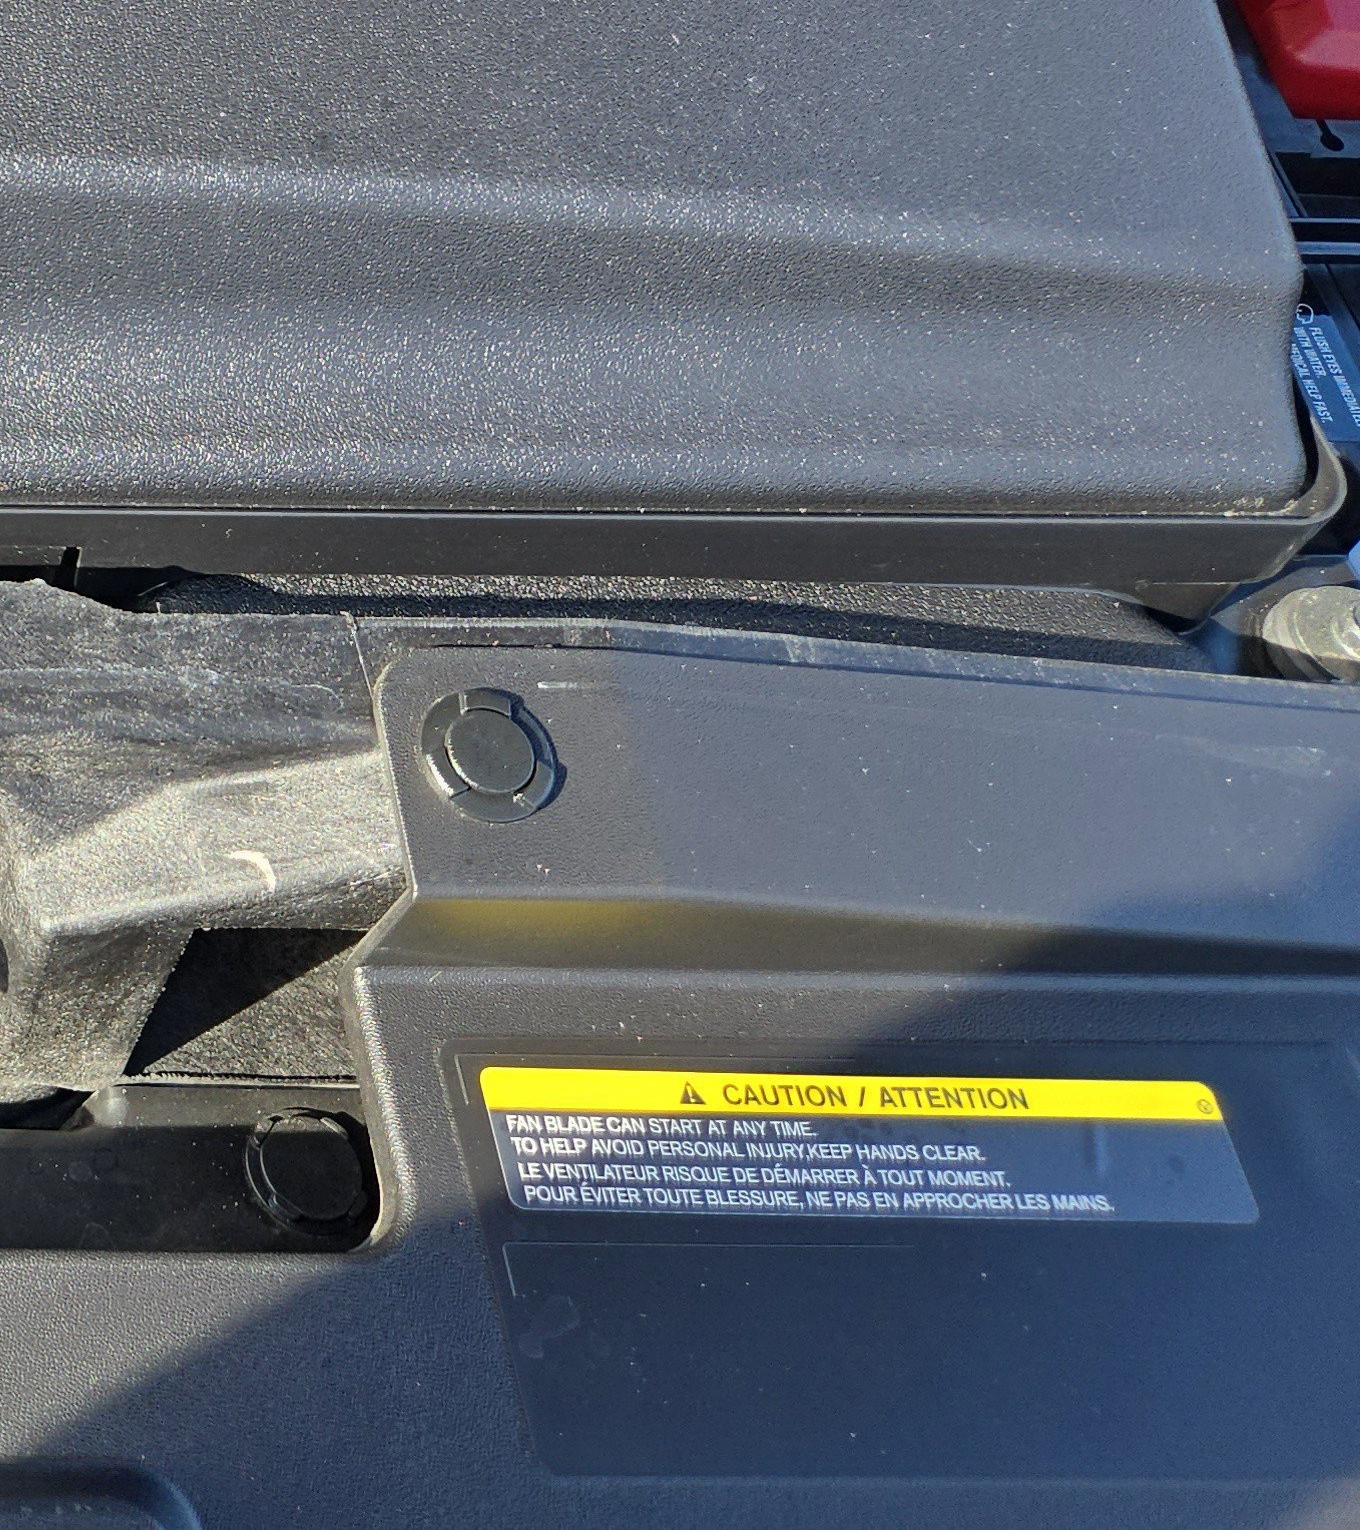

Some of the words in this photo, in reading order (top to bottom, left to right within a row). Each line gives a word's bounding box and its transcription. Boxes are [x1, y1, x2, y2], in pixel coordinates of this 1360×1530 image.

[1294, 327, 1313, 348] WITH
[1309, 326, 1332, 353] FLUSH
[1323, 354, 1342, 375] EYES
[1302, 379, 1322, 401] HELP
[1313, 401, 1334, 424] FAST.
[722, 1083, 847, 1107] CAUTION
[880, 1086, 1029, 1110] ATTENTION
[506, 1114, 540, 1132] FAN
[544, 1115, 604, 1133] BLADE
[606, 1117, 645, 1134] CAN
[649, 1118, 702, 1135] START
[708, 1120, 727, 1135] AT
[733, 1120, 766, 1136] ANY
[771, 1121, 817, 1137] TIME.
[511, 1136, 537, 1154] TO
[540, 1137, 586, 1155] HELP
[591, 1139, 644, 1156] AVOID
[647, 1142, 746, 1158] PERSONAL
[857, 1144, 918, 1160] HANDS
[923, 1145, 986, 1161] CLEAR.
[517, 1162, 540, 1179] LE
[541, 1163, 659, 1181] VENTILATEUR
[662, 1166, 732, 1184] RISQUE
[734, 1168, 758, 1184] DE
[762, 1163, 859, 1185] DÉMARRER
[862, 1164, 878, 1185] À
[881, 1170, 925, 1186] TOUT
[929, 1171, 1011, 1188] MOMENT.
[524, 1186, 579, 1204] POUR
[580, 1182, 640, 1204] ÉVITER
[642, 1187, 705, 1205] TOUTE
[707, 1190, 804, 1209] BLESSURE,
[805, 1191, 834, 1208] NE
[836, 1192, 870, 1208] PAS
[873, 1192, 899, 1209] EN
[903, 1192, 1014, 1211] APPROCHER
[1015, 1194, 1051, 1211] LES
[1051, 1195, 1115, 1212] MAINS.
